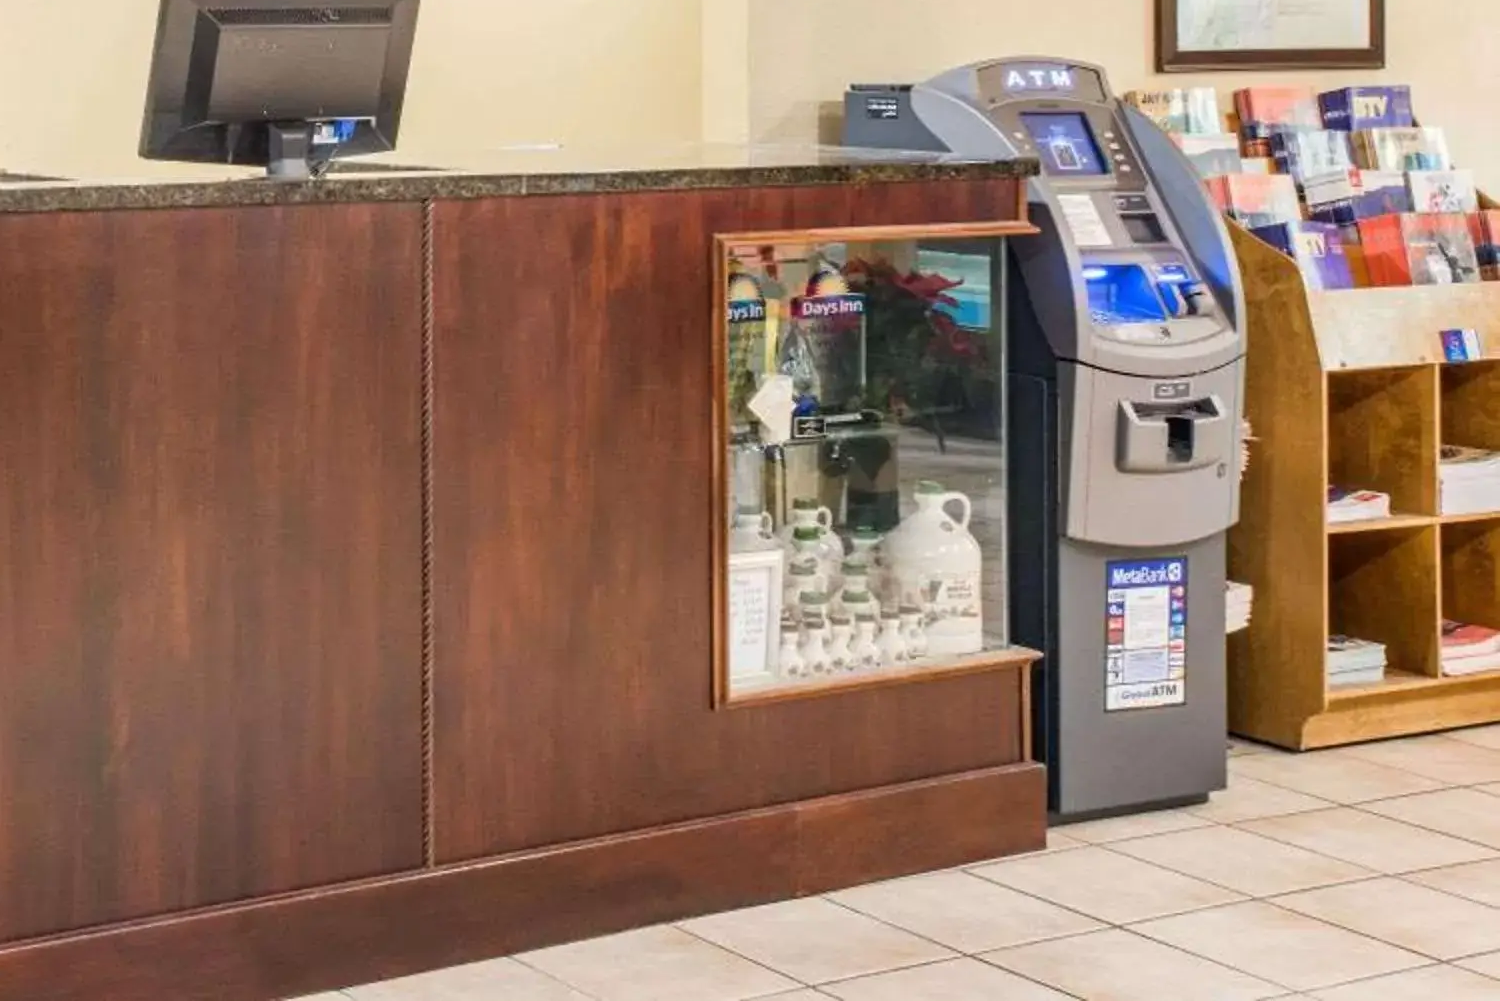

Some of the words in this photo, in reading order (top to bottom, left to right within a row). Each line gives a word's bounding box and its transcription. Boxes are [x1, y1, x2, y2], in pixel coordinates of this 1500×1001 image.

[1007, 69, 1073, 87] ATM
[803, 301, 838, 317] Days
[840, 299, 864, 313] Inn
[1112, 564, 1168, 585] MetaBank
